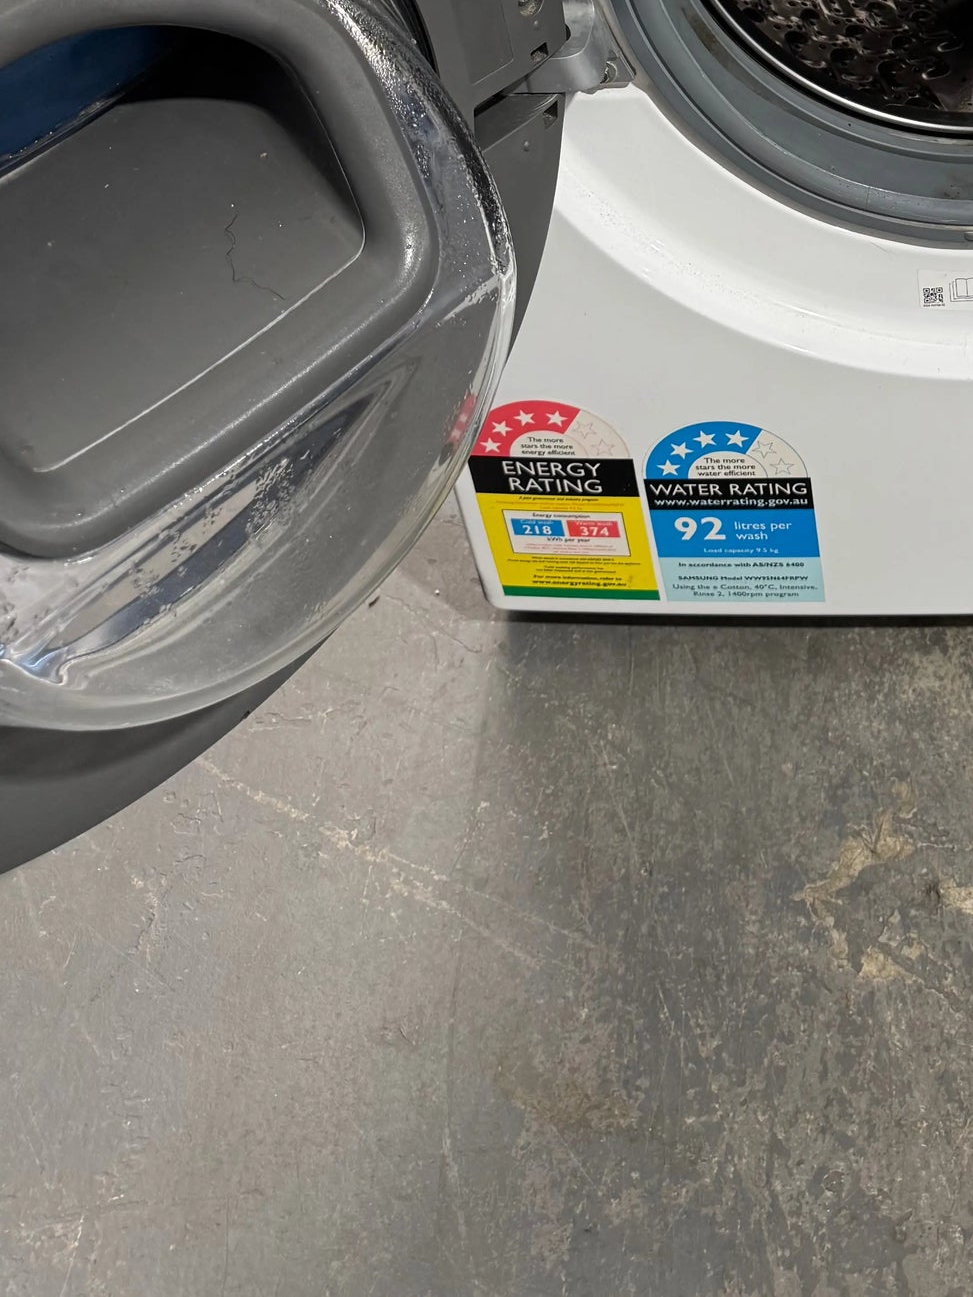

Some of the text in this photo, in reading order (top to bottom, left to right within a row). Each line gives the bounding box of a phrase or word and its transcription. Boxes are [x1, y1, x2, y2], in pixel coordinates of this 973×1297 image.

[502, 461, 600, 477] ENERGY
[508, 478, 602, 493] RATING
[650, 483, 807, 496] WATER RATING
[654, 498, 807, 507] www.waterrating.gov.au
[522, 525, 552, 534] 218
[580, 527, 609, 536] 374
[674, 517, 792, 540] 92 litres per
